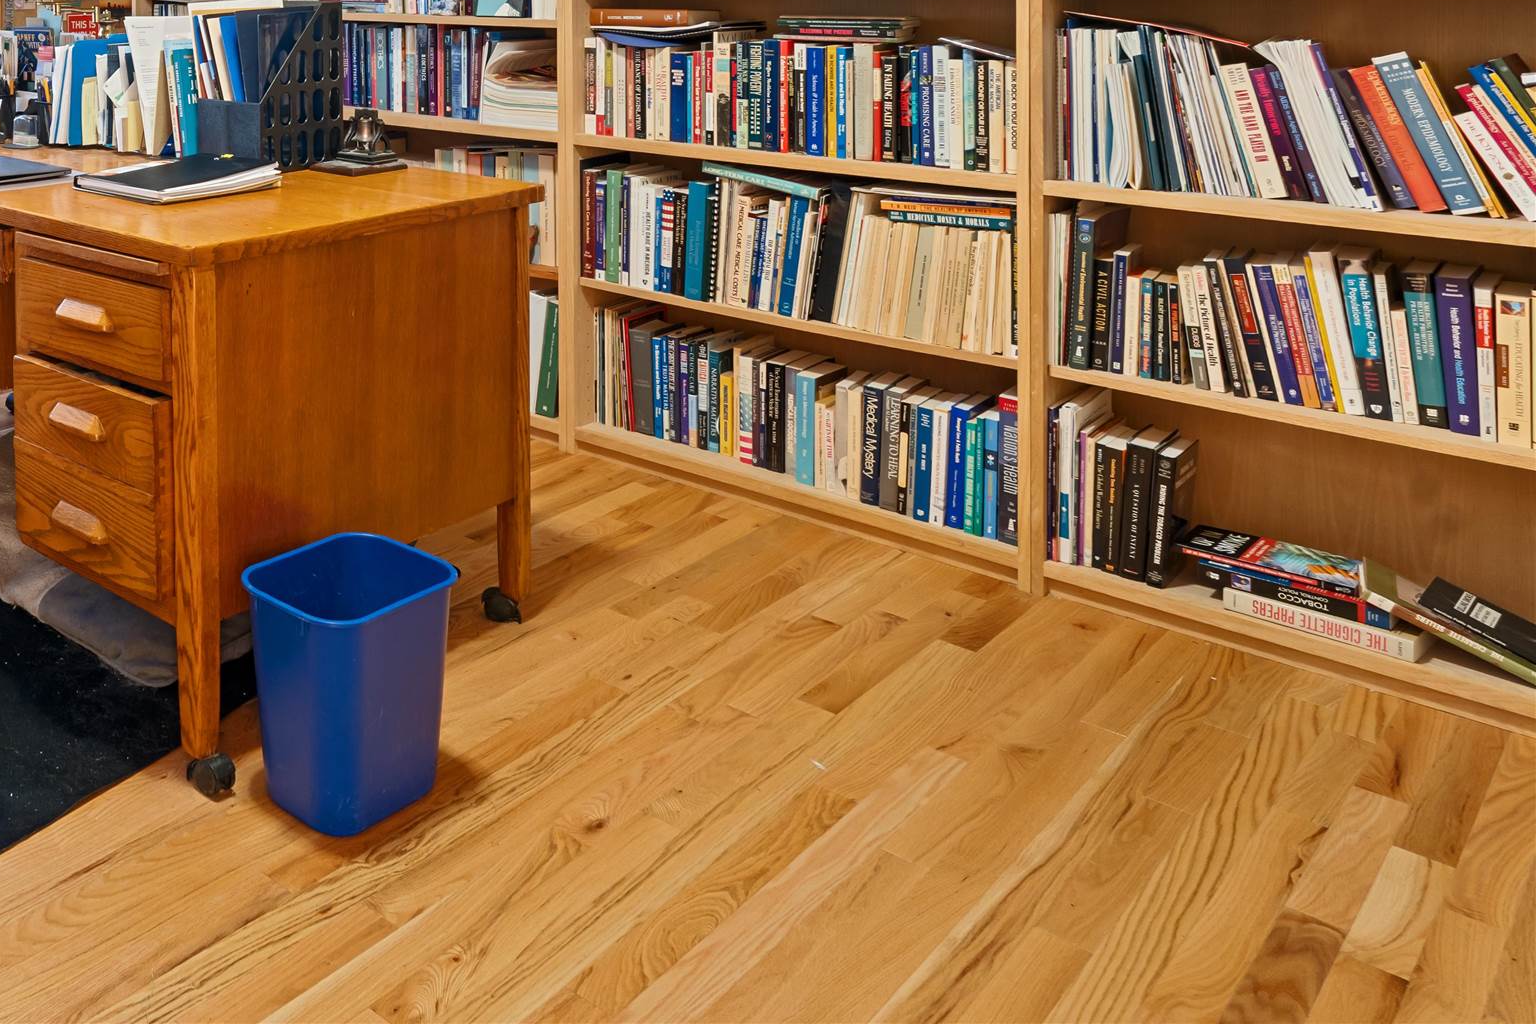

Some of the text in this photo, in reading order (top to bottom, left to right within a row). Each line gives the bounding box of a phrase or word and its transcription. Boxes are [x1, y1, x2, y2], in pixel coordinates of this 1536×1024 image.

[70, 20, 87, 29] THIS
[635, 50, 643, 63] THE
[634, 63, 643, 83] DANCE
[749, 44, 763, 97] FIGHTING POVERTY
[810, 74, 819, 94] Sickness
[883, 63, 894, 128] IN FAILING HEALTH
[1234, 89, 1250, 101] AND
[810, 99, 818, 115] Health
[1238, 102, 1254, 114] THE
[1367, 70, 1402, 126] Epidemiology
[634, 92, 643, 131] LEGISLATION
[921, 86, 931, 149] PROMISING CARE
[1242, 116, 1258, 132] BAND
[1465, 91, 1500, 135] Epidemiology
[810, 120, 818, 138] America
[1351, 109, 1388, 169] EPIDEMIOLOGY
[1402, 87, 1453, 173] MODERN EPIDEMIOLOGY
[1247, 133, 1266, 155] PLAYED
[906, 212, 936, 224] MEDICINE,
[936, 213, 957, 225] MONEY
[964, 216, 990, 228] MORALS
[731, 206, 745, 297] MEDICAL CARE, MEDICAL COSTS
[1095, 278, 1109, 301] CIVIL
[1198, 293, 1210, 306] The
[1094, 302, 1108, 332] ACTION
[1347, 286, 1363, 326] Populations
[1358, 277, 1379, 357] Health Behavior Change
[1449, 307, 1461, 324] Health
[1199, 307, 1214, 332] Picture
[1190, 327, 1201, 348] DUBOS
[1450, 324, 1463, 349] Behavior
[1205, 342, 1219, 367] Health
[1514, 342, 1526, 382] EDUCATING
[1454, 359, 1464, 377] Health
[662, 383, 670, 410] MATTERS
[710, 367, 718, 437] NARRATIVE MATTERS
[1455, 377, 1467, 405] Education
[1515, 391, 1525, 417] HEALTH
[863, 397, 878, 479] Medical Mystery
[887, 396, 901, 480] LEARNING TO HEAL
[1003, 425, 1018, 495] Nation's Health
[1153, 484, 1168, 564] ENDING THE TOBACCO PROBLEM
[1276, 584, 1329, 603] CONTROL POLICY
[1277, 591, 1330, 612] TOBACCO
[1251, 600, 1389, 654] THE CIGARETTE PAPERS
[1414, 613, 1446, 633] SELLERS
